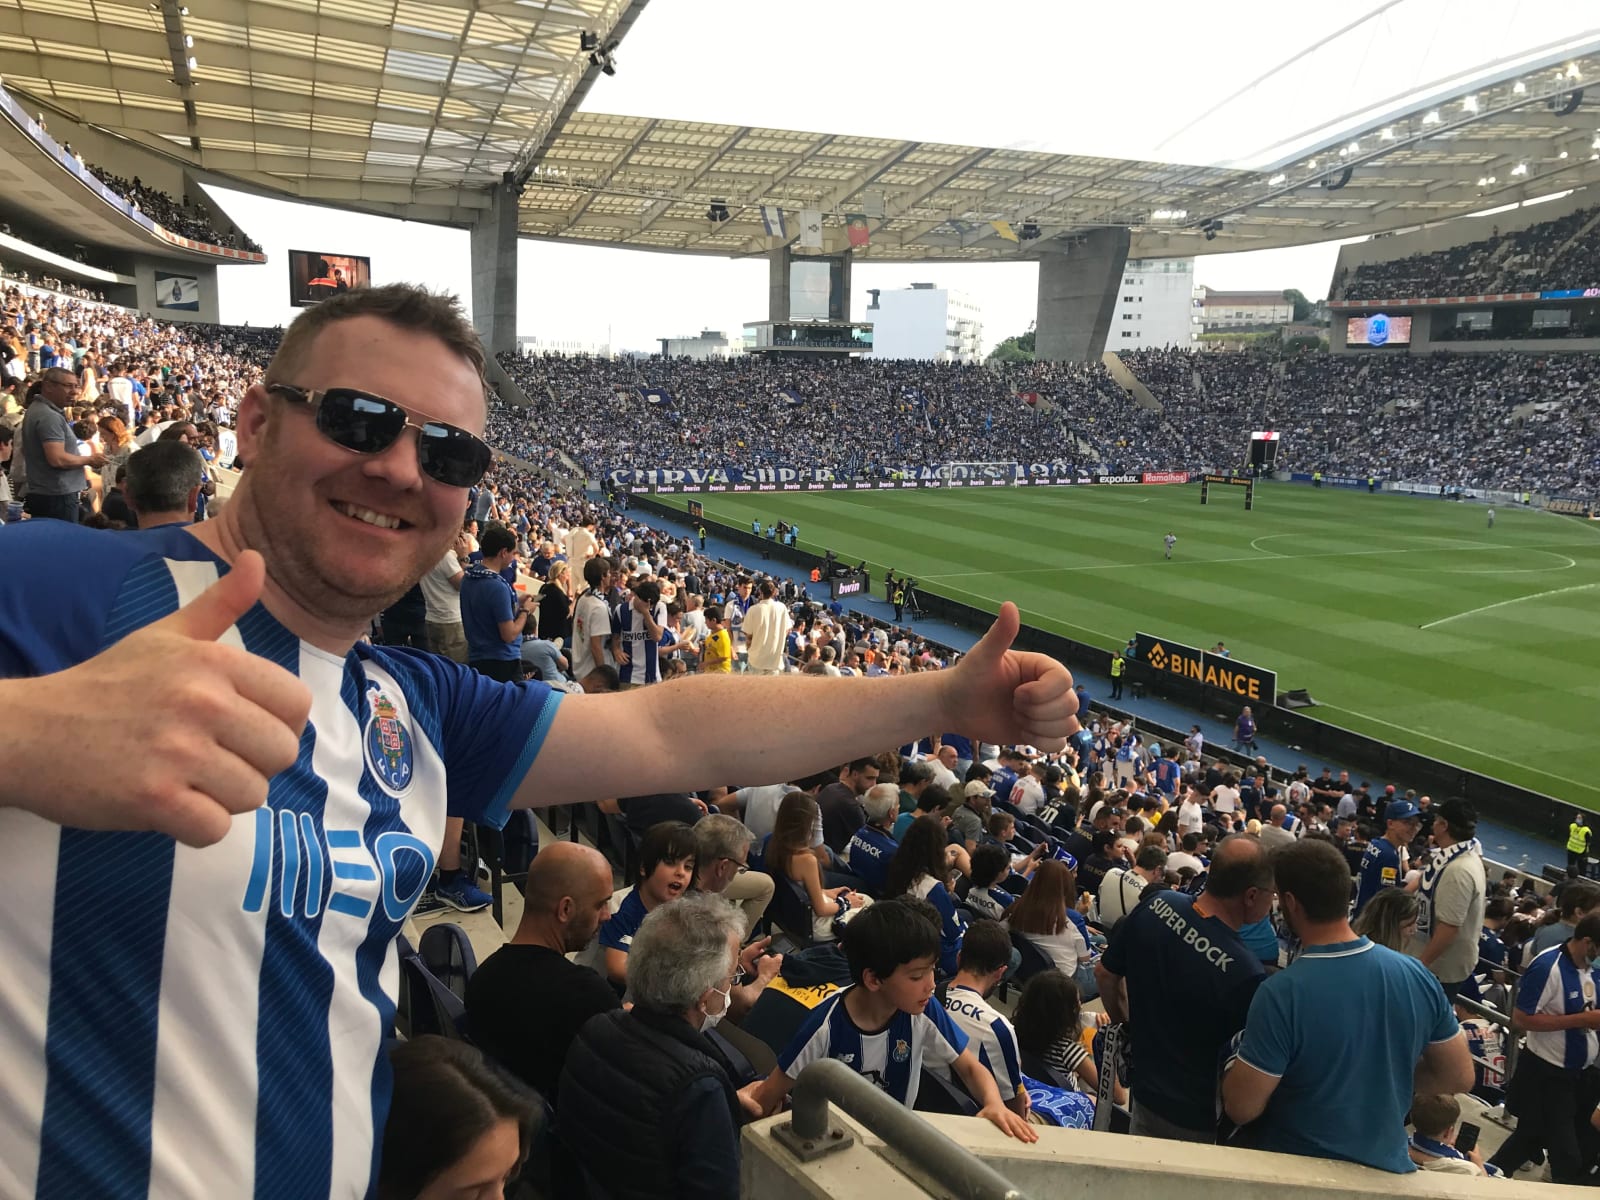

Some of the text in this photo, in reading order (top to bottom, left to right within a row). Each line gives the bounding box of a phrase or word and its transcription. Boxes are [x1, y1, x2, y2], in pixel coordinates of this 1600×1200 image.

[839, 582, 860, 594] bwin
[1171, 653, 1260, 700] BINANCE
[861, 841, 883, 858] BOCK
[242, 806, 436, 923] MEO
[1128, 878, 1144, 891] BOC
[1148, 897, 1235, 974] SUPER BOCK
[945, 997, 985, 1021] BOCK
